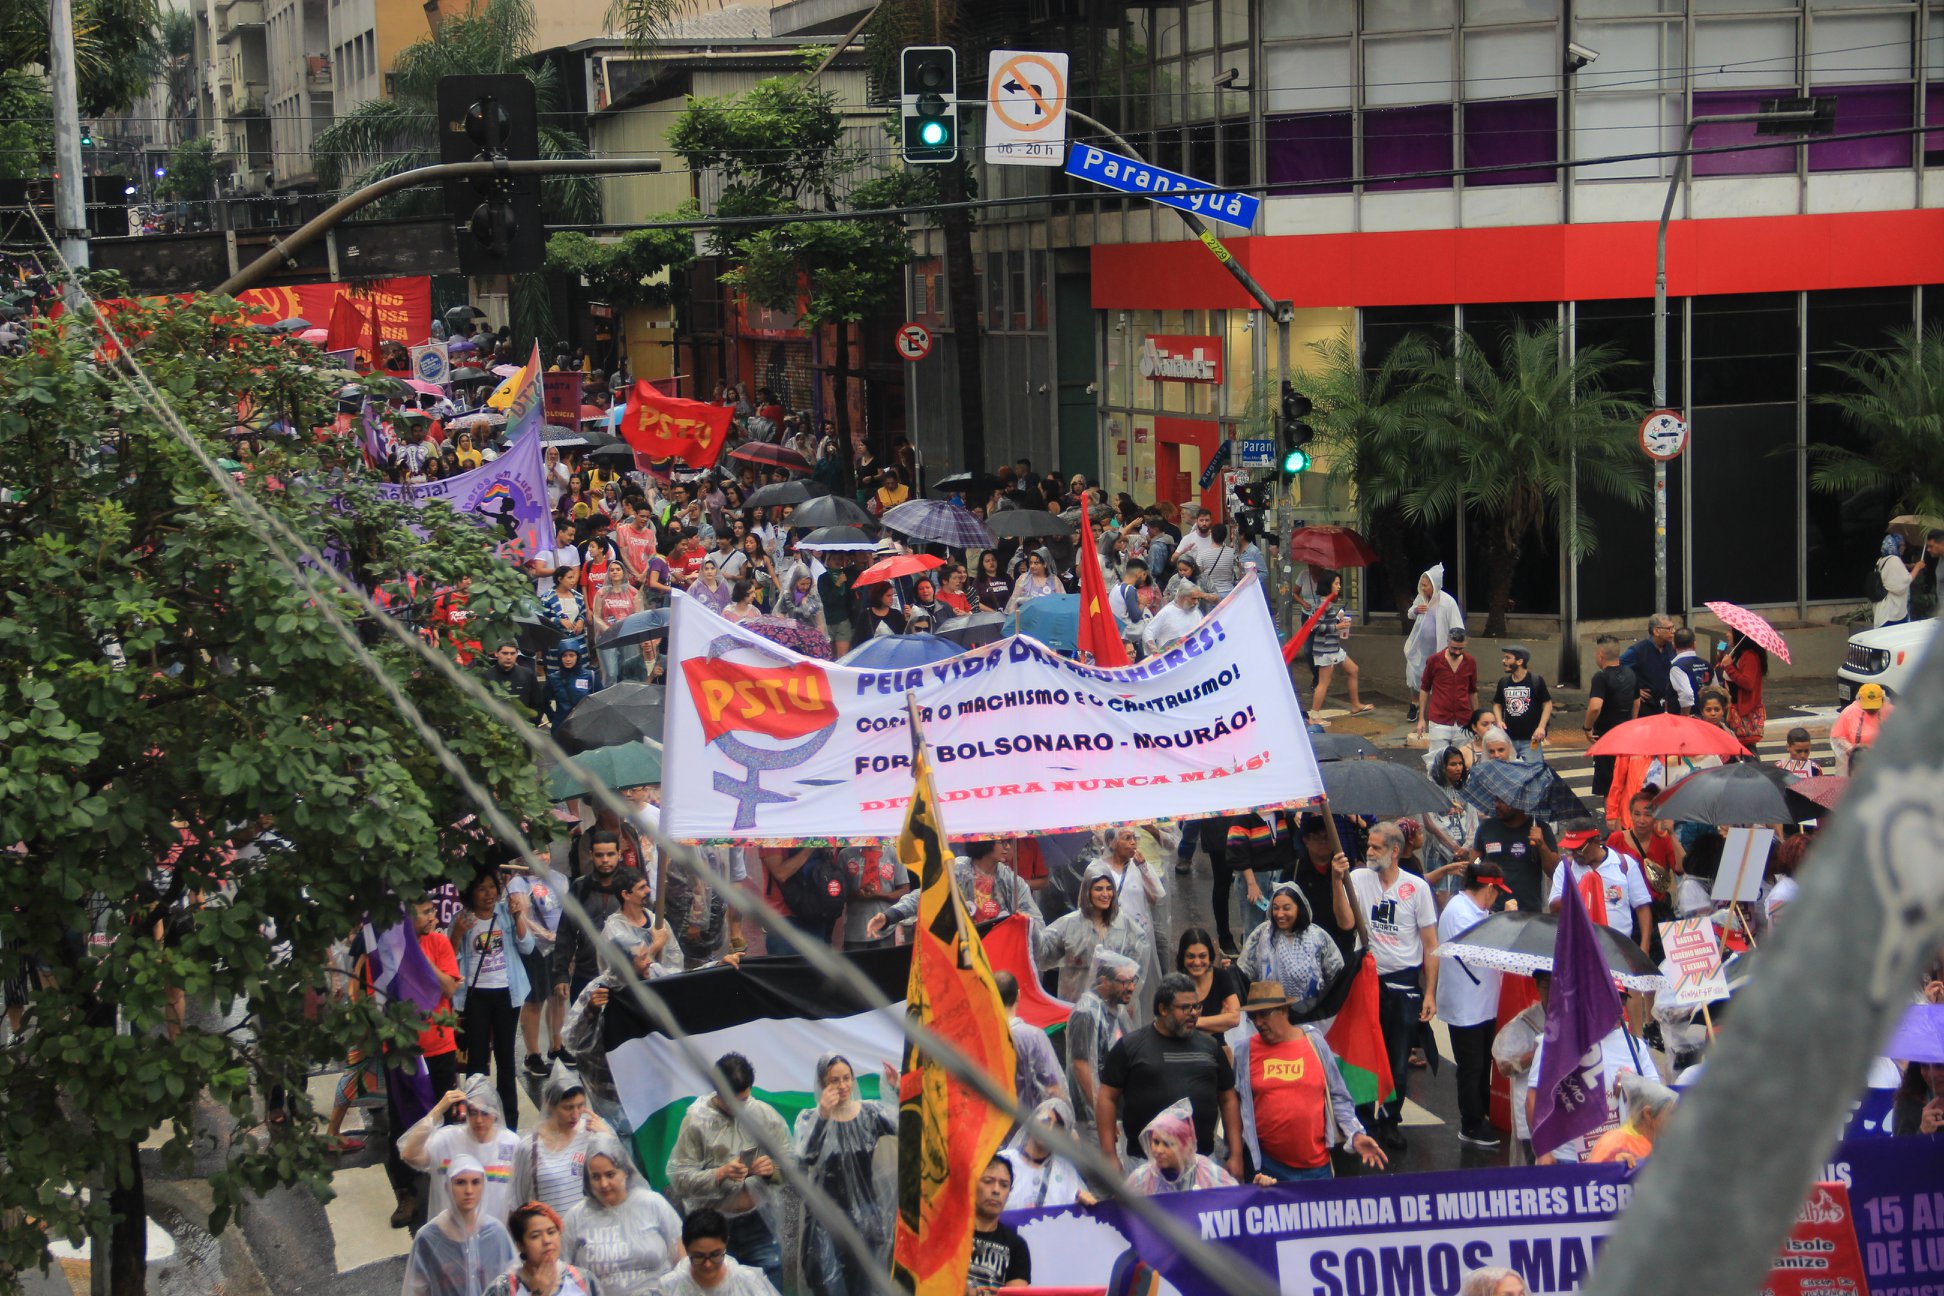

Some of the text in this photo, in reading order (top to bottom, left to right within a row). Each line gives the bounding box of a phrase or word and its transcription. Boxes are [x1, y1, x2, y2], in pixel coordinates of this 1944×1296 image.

[997, 143, 1013, 155] 06
[1025, 143, 1041, 155] 20
[1045, 144, 1054, 156] h
[1083, 149, 1242, 217] Paranaguá
[1206, 238, 1229, 260] 2729
[638, 405, 712, 449] PSTU
[1243, 441, 1275, 452] Paran
[857, 670, 924, 695] PELA
[932, 646, 1003, 684] VIDA
[701, 675, 825, 722] PSTU
[939, 706, 952, 720] O
[957, 688, 1070, 717] MACHISMO
[936, 732, 1114, 763] BOLSONARO
[1134, 705, 1257, 750] MOURÃO!
[858, 750, 1270, 812] DITDURA NUNCA MAIS!
[1267, 1063, 1301, 1074] PSTU
[1199, 1209, 1241, 1241] XVI
[1245, 1197, 1396, 1236] CAMINHADA
[1400, 1193, 1432, 1223] DE
[1436, 1186, 1570, 1222] MULHERES
[1864, 1195, 1905, 1235] 15
[585, 1243, 629, 1261] COMO
[586, 1225, 620, 1243] LUTE
[1309, 1234, 1610, 1296] SOMOS MA
[1866, 1239, 1906, 1276] DE
